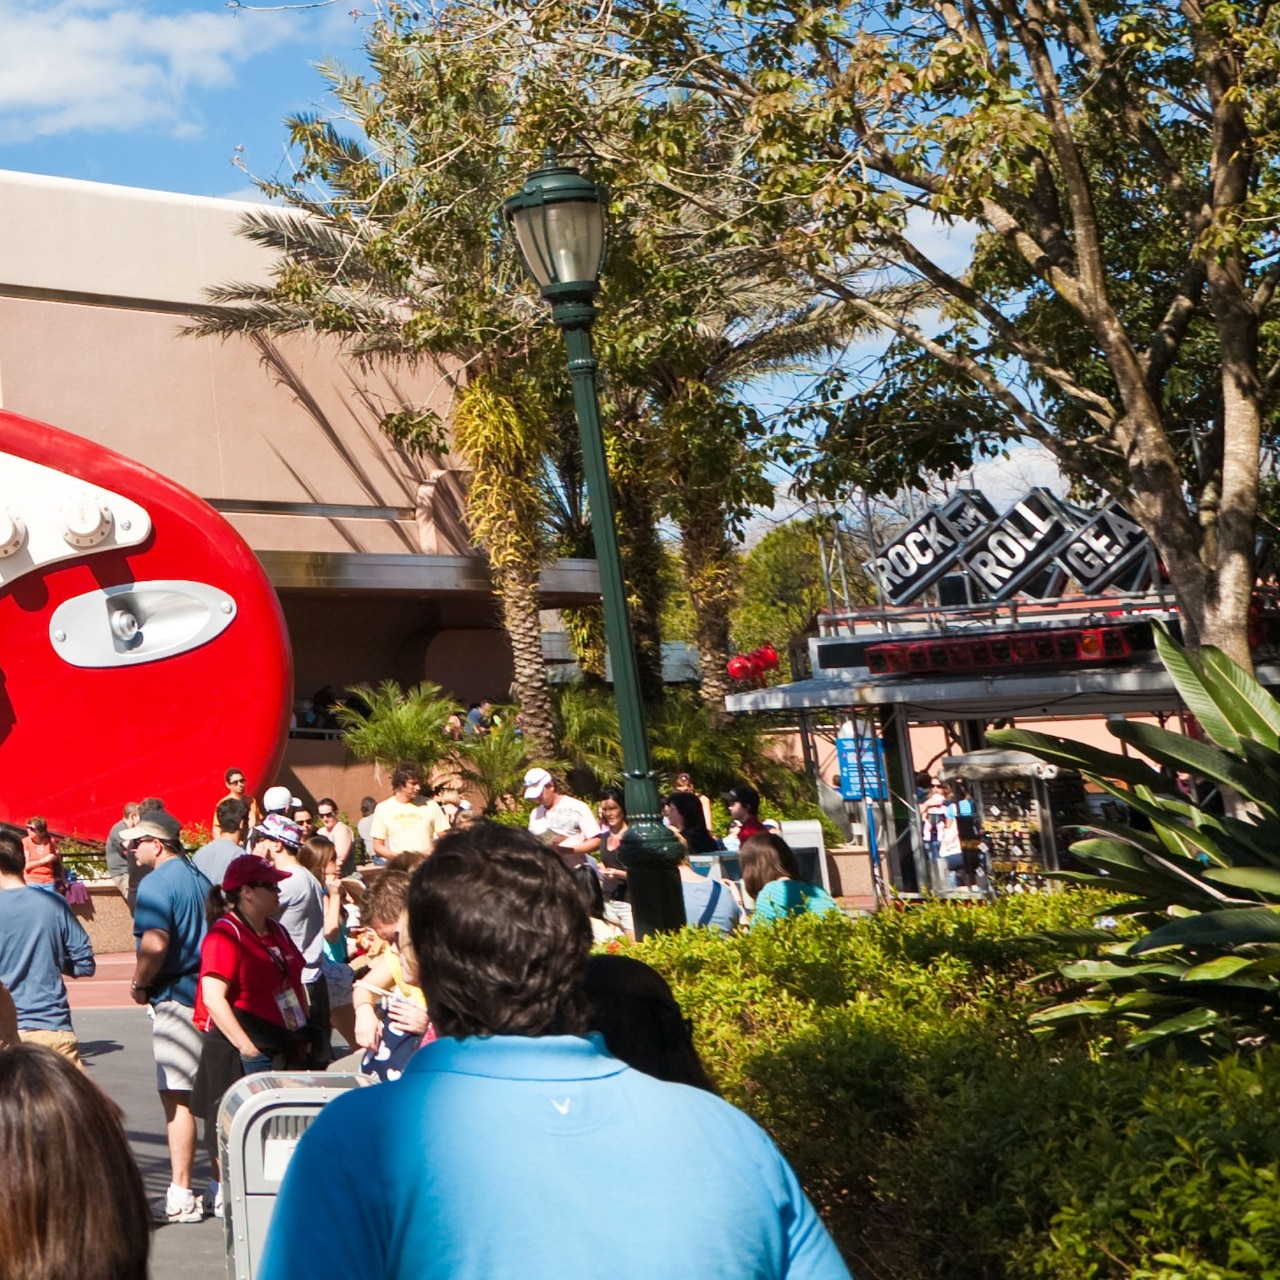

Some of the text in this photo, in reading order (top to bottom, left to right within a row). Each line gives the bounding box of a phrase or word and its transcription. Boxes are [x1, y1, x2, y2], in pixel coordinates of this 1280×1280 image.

[869, 516, 956, 593] ROCK
[968, 501, 1061, 590] ROLL
[1066, 509, 1144, 578] GEA
